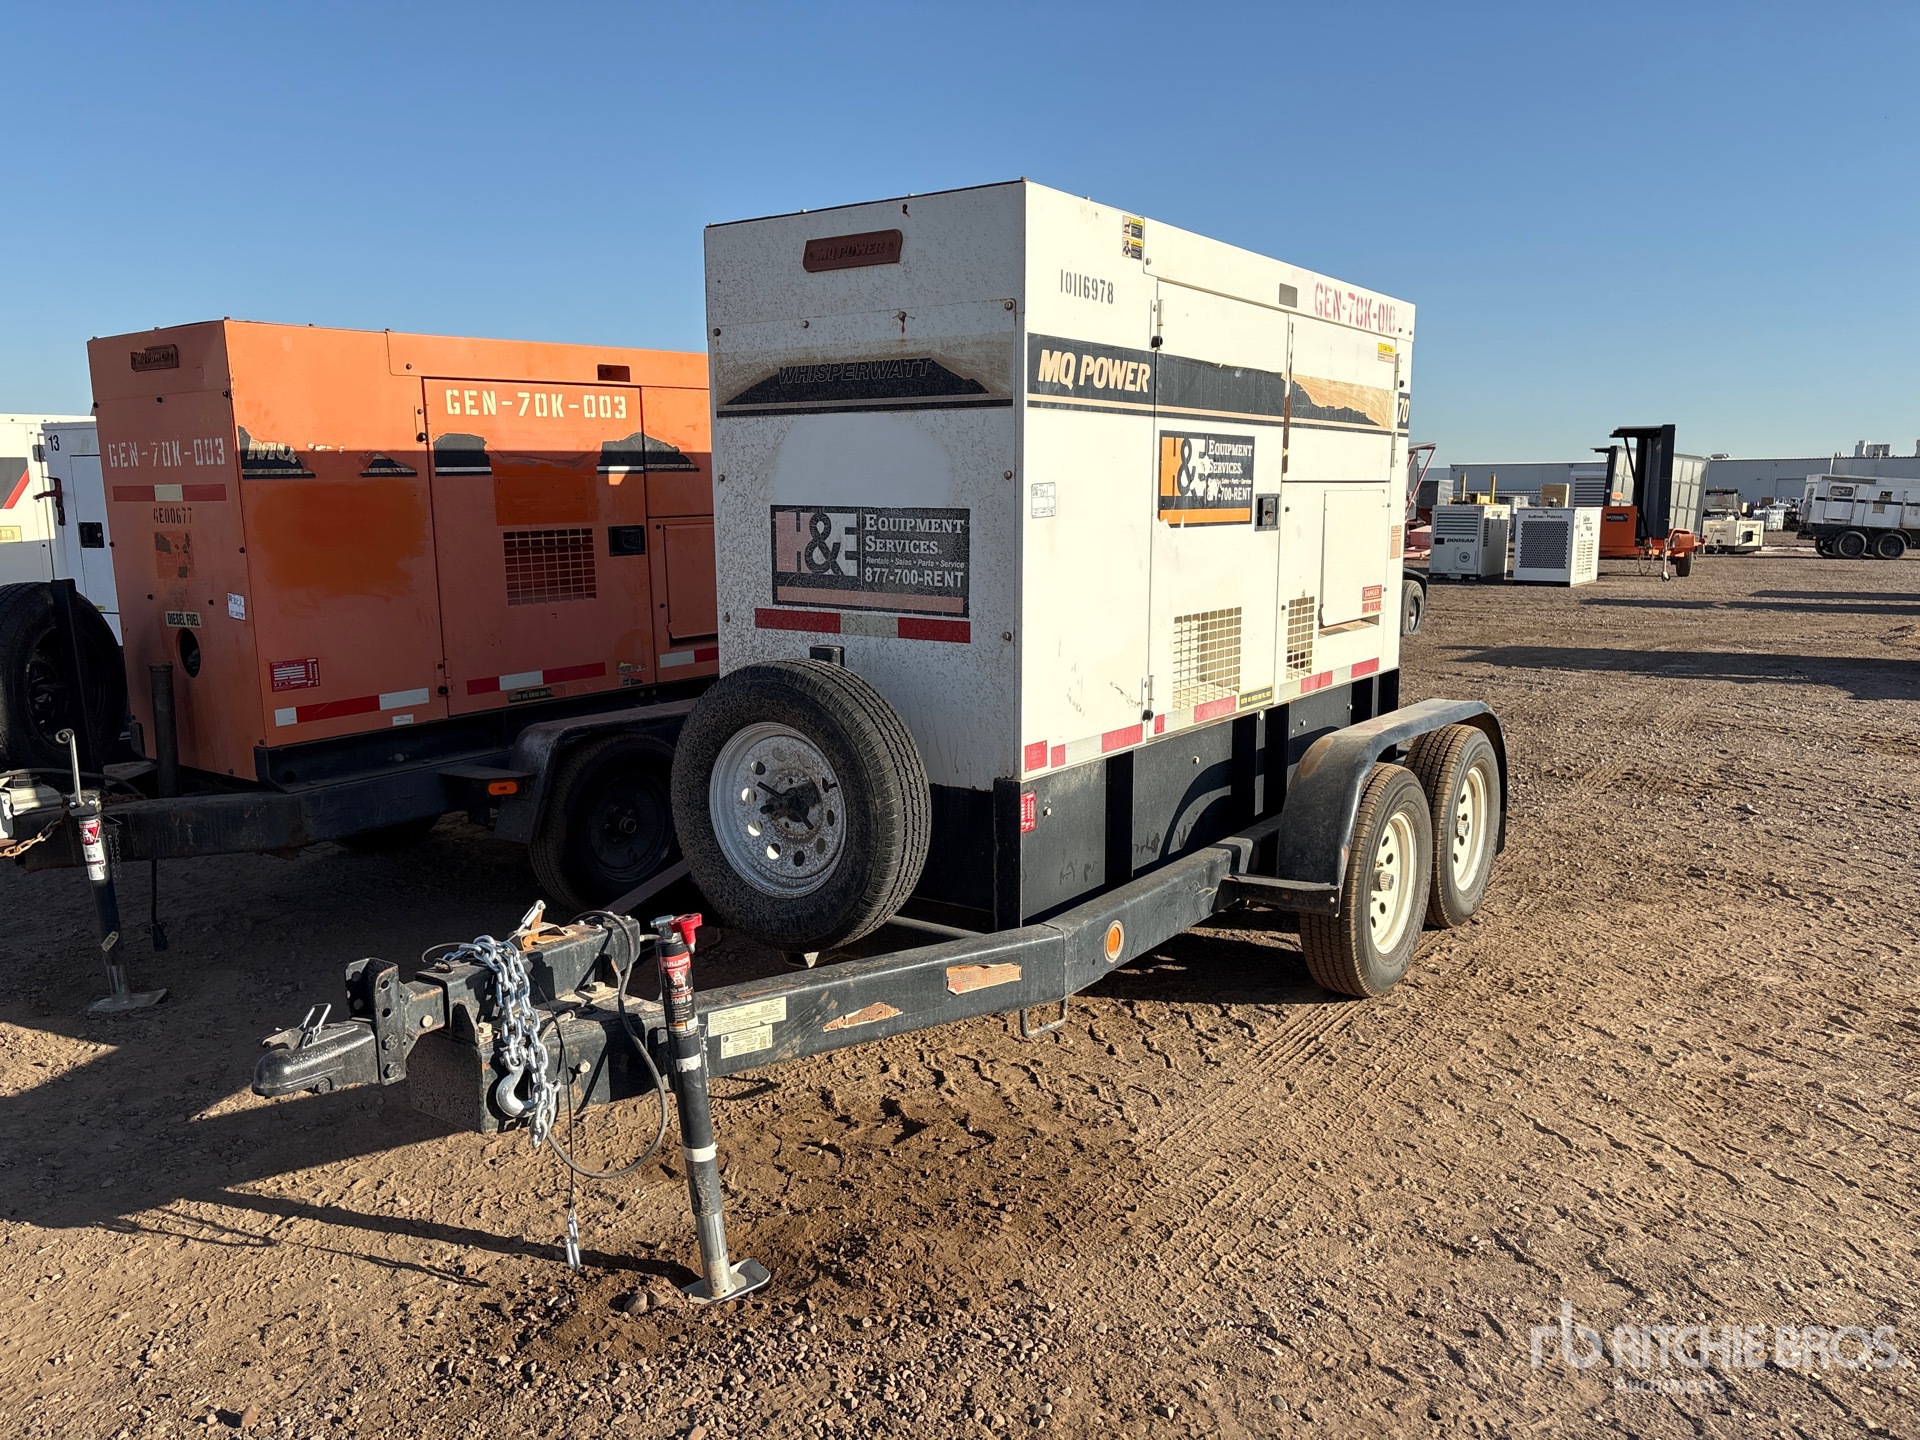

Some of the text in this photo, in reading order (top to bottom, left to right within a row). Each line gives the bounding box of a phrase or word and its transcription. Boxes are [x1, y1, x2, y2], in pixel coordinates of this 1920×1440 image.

[838, 241, 886, 258] POWER
[1060, 268, 1114, 305] 10116978
[778, 357, 933, 385] WHISPERWATT
[1037, 349, 1151, 393] MQ POWER
[445, 388, 627, 420] GEN-70K-003
[1398, 397, 1410, 424] 70
[48, 434, 60, 452] 13
[107, 437, 226, 468] GEN-70K-003
[1208, 440, 1253, 457] EQUIPMENT
[864, 513, 965, 534] EQUIPMENT
[775, 511, 858, 577] H&E
[866, 556, 965, 569] Rentals Sales Parts Service
[864, 566, 965, 588] 877-700-RENT
[167, 611, 200, 627] DIESEL FUEL
